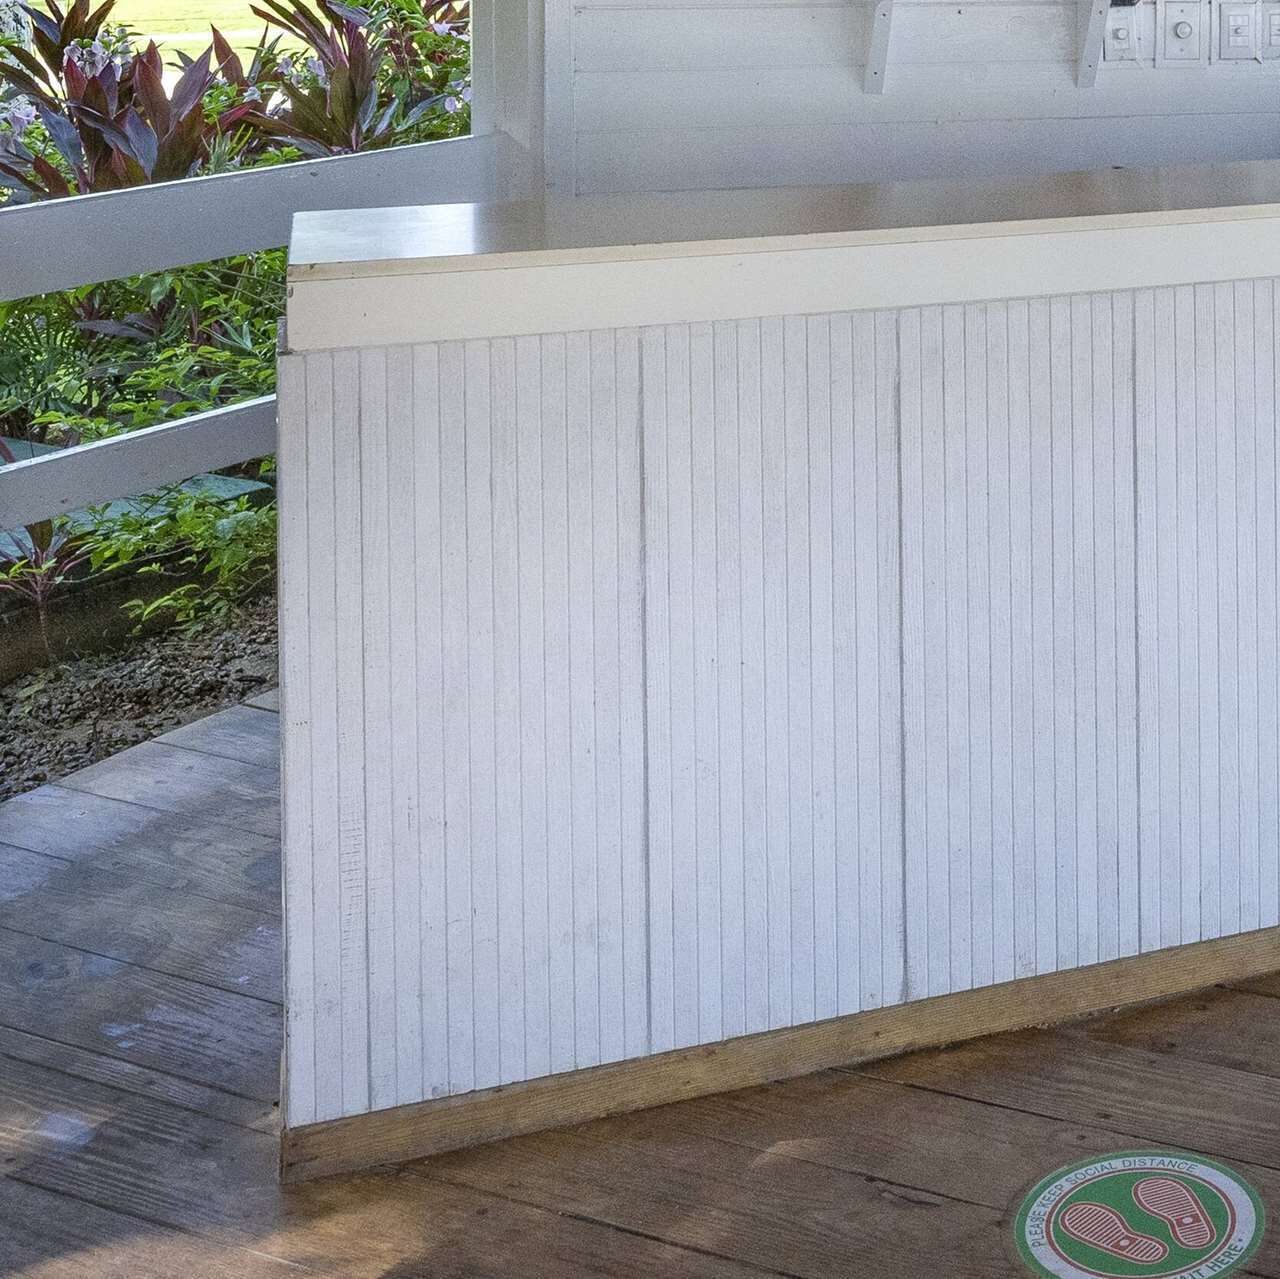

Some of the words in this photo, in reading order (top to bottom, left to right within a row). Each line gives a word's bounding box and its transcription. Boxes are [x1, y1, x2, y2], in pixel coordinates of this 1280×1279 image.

[1066, 1161, 1118, 1185] SOCIAL
[1122, 1158, 1200, 1173] DISTANCE
[1037, 1183, 1065, 1209] KEEP
[1029, 1210, 1047, 1248] PLEASE
[1206, 1242, 1244, 1273] HERE
